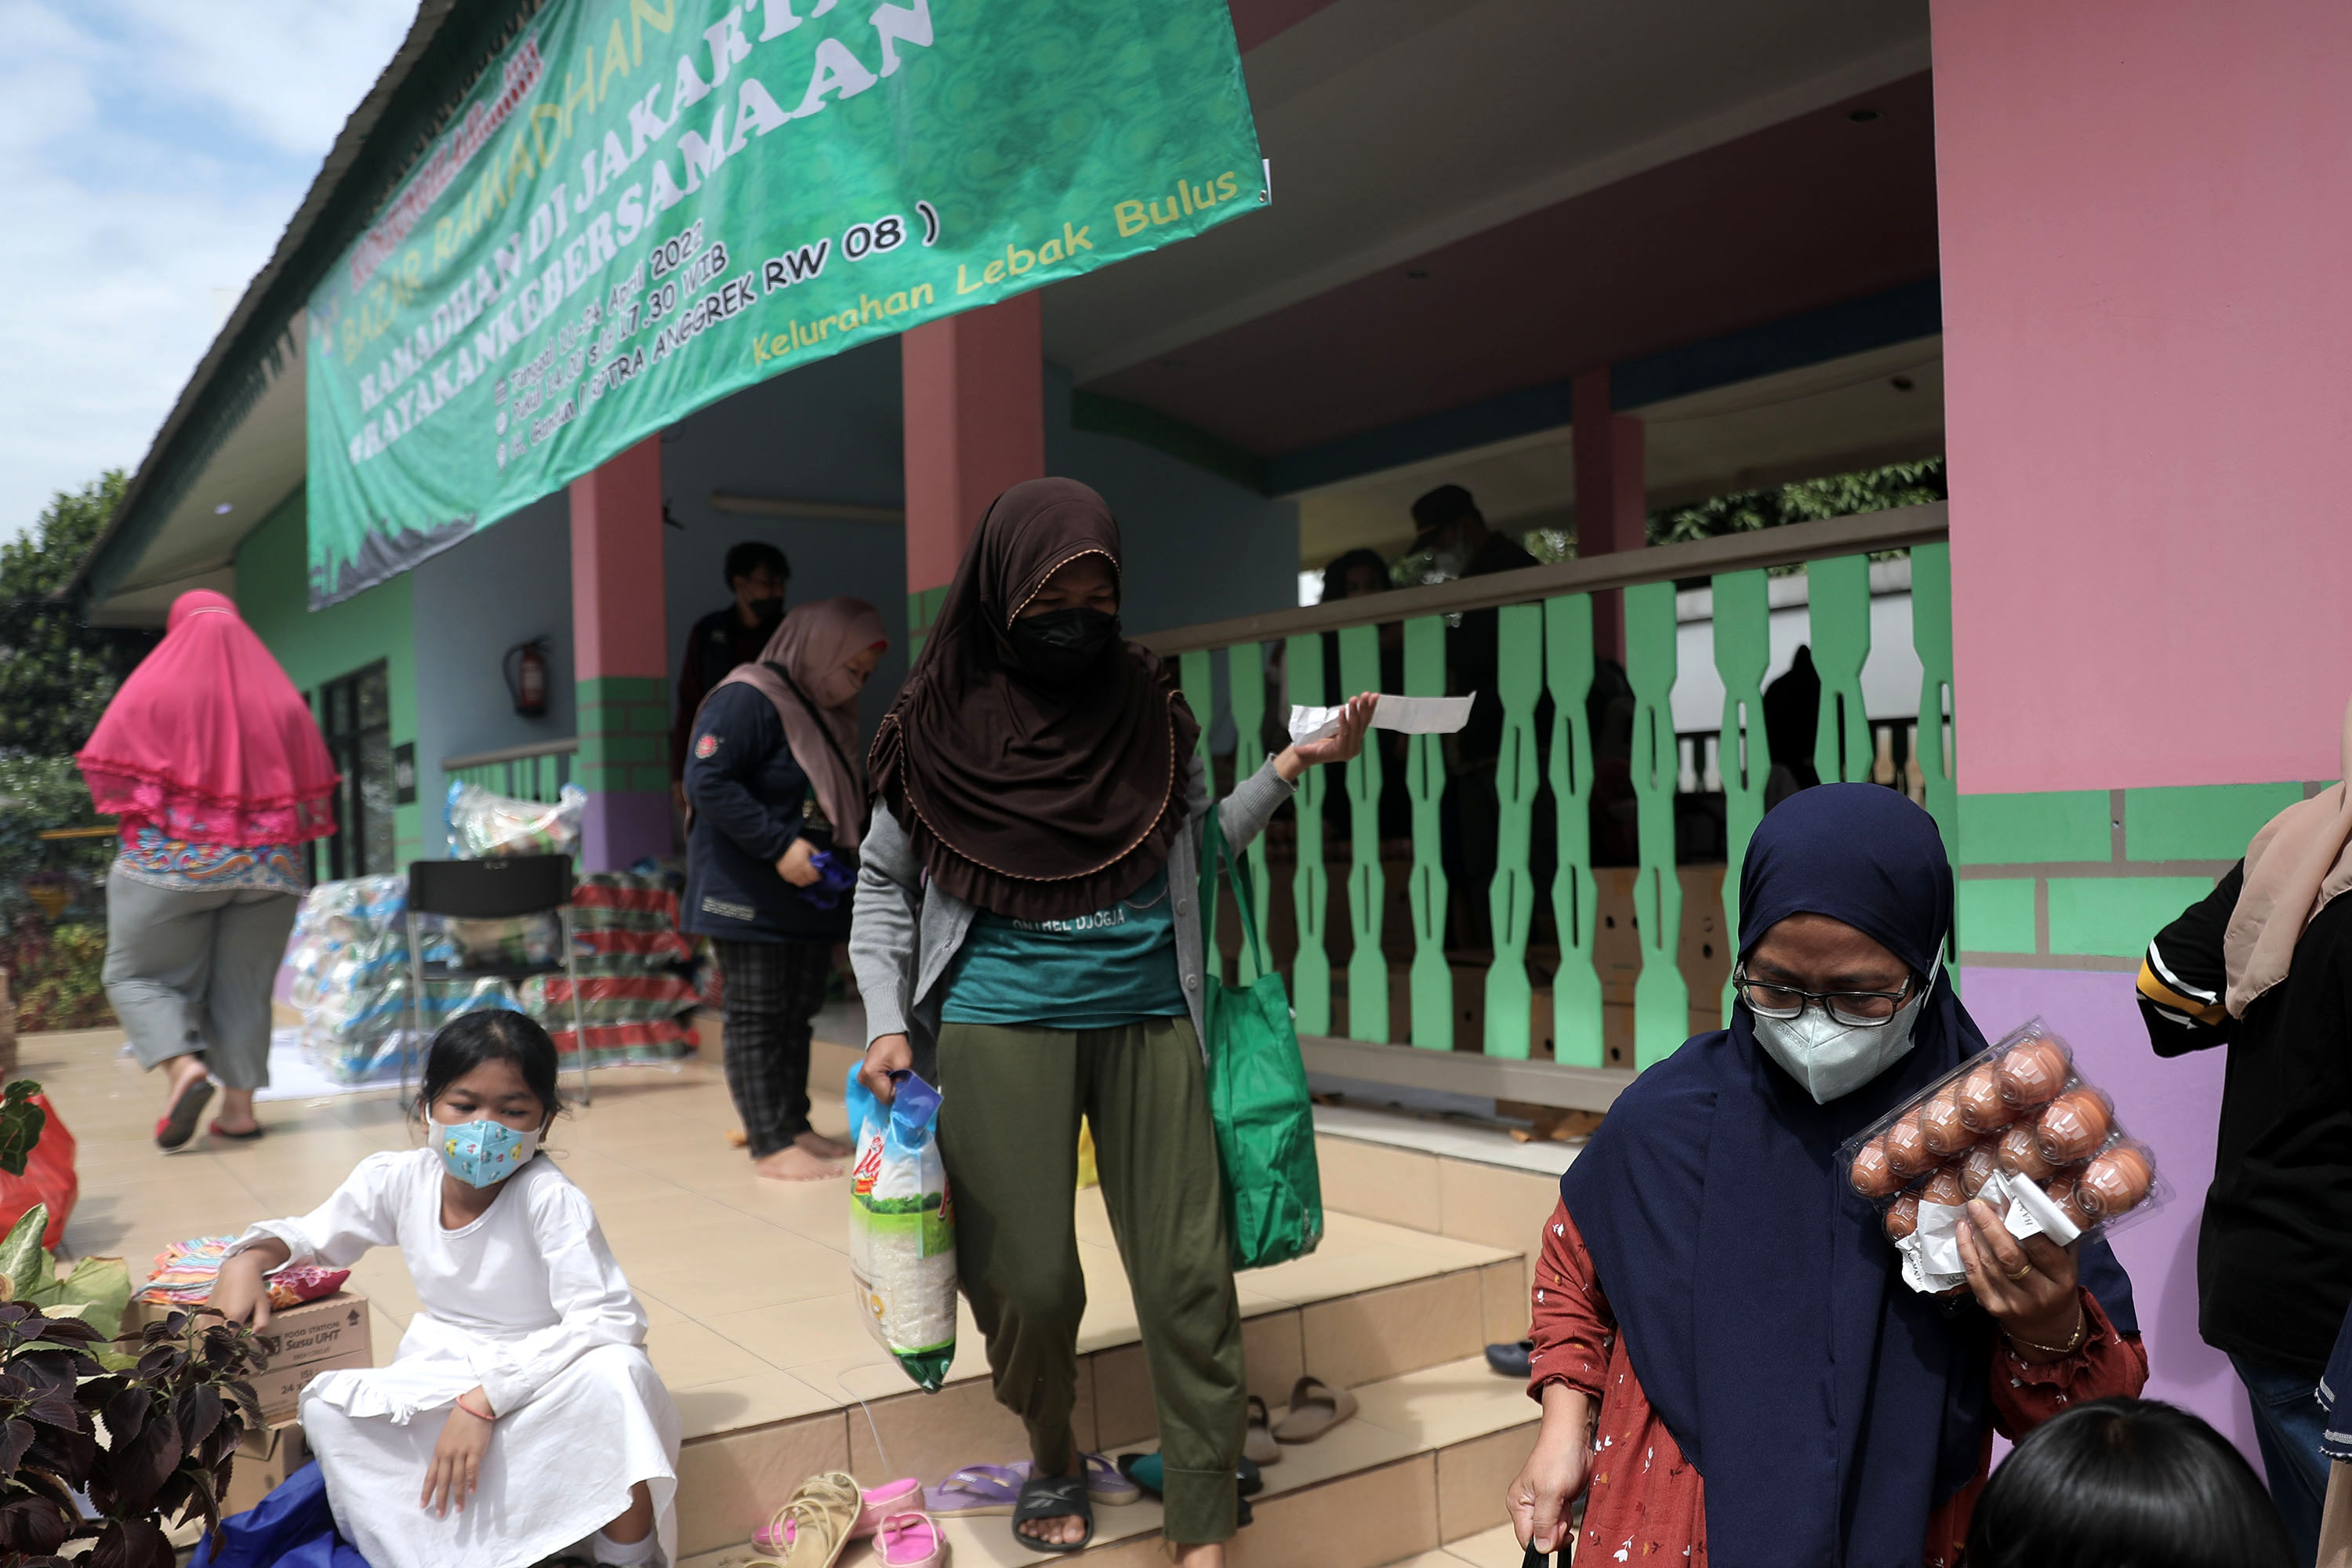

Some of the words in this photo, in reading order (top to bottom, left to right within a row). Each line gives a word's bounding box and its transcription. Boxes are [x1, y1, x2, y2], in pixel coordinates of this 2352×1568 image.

[342, 249, 424, 366] BAZAR
[434, 0, 674, 274] RAMADHAN
[359, 232, 521, 415] RAMADHAN
[528, 183, 568, 265] DI
[575, 0, 839, 214] JAKART
[619, 281, 677, 343] 17.30
[681, 241, 729, 298] WIB
[652, 270, 757, 365] ANGGREK
[762, 238, 832, 296] RW
[840, 213, 906, 263] 08
[752, 282, 935, 366] Kelurahan
[956, 221, 1095, 296] Lebak
[1113, 169, 1239, 239] Bulus
[1075, 908, 1126, 931] DJOGJA
[284, 1329, 306, 1341] FOOD
[308, 1321, 340, 1334] STATION
[285, 1338, 314, 1352] Susu
[315, 1329, 341, 1345] UHT
